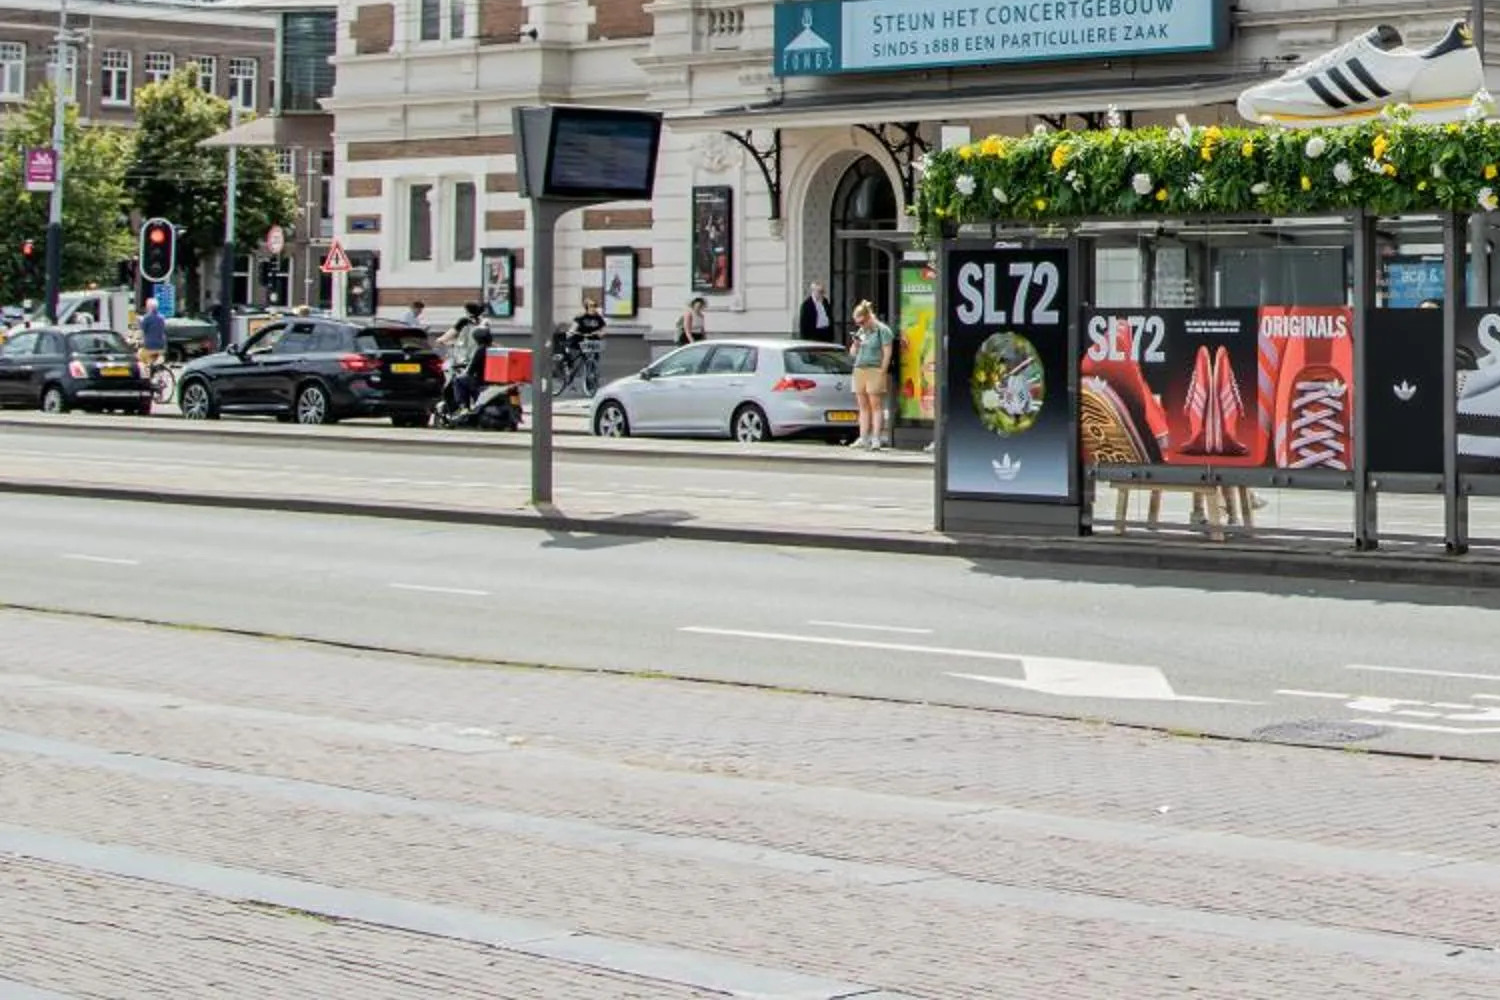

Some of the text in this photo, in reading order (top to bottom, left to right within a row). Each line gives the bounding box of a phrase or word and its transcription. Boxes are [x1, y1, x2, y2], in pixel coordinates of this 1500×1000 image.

[873, 10, 936, 33] STEUN
[943, 7, 978, 29] HET
[873, 23, 1168, 57] SINDS 1888 EEN PARTICULIERE ZAAK
[1261, 314, 1347, 338] ORIGINALS
